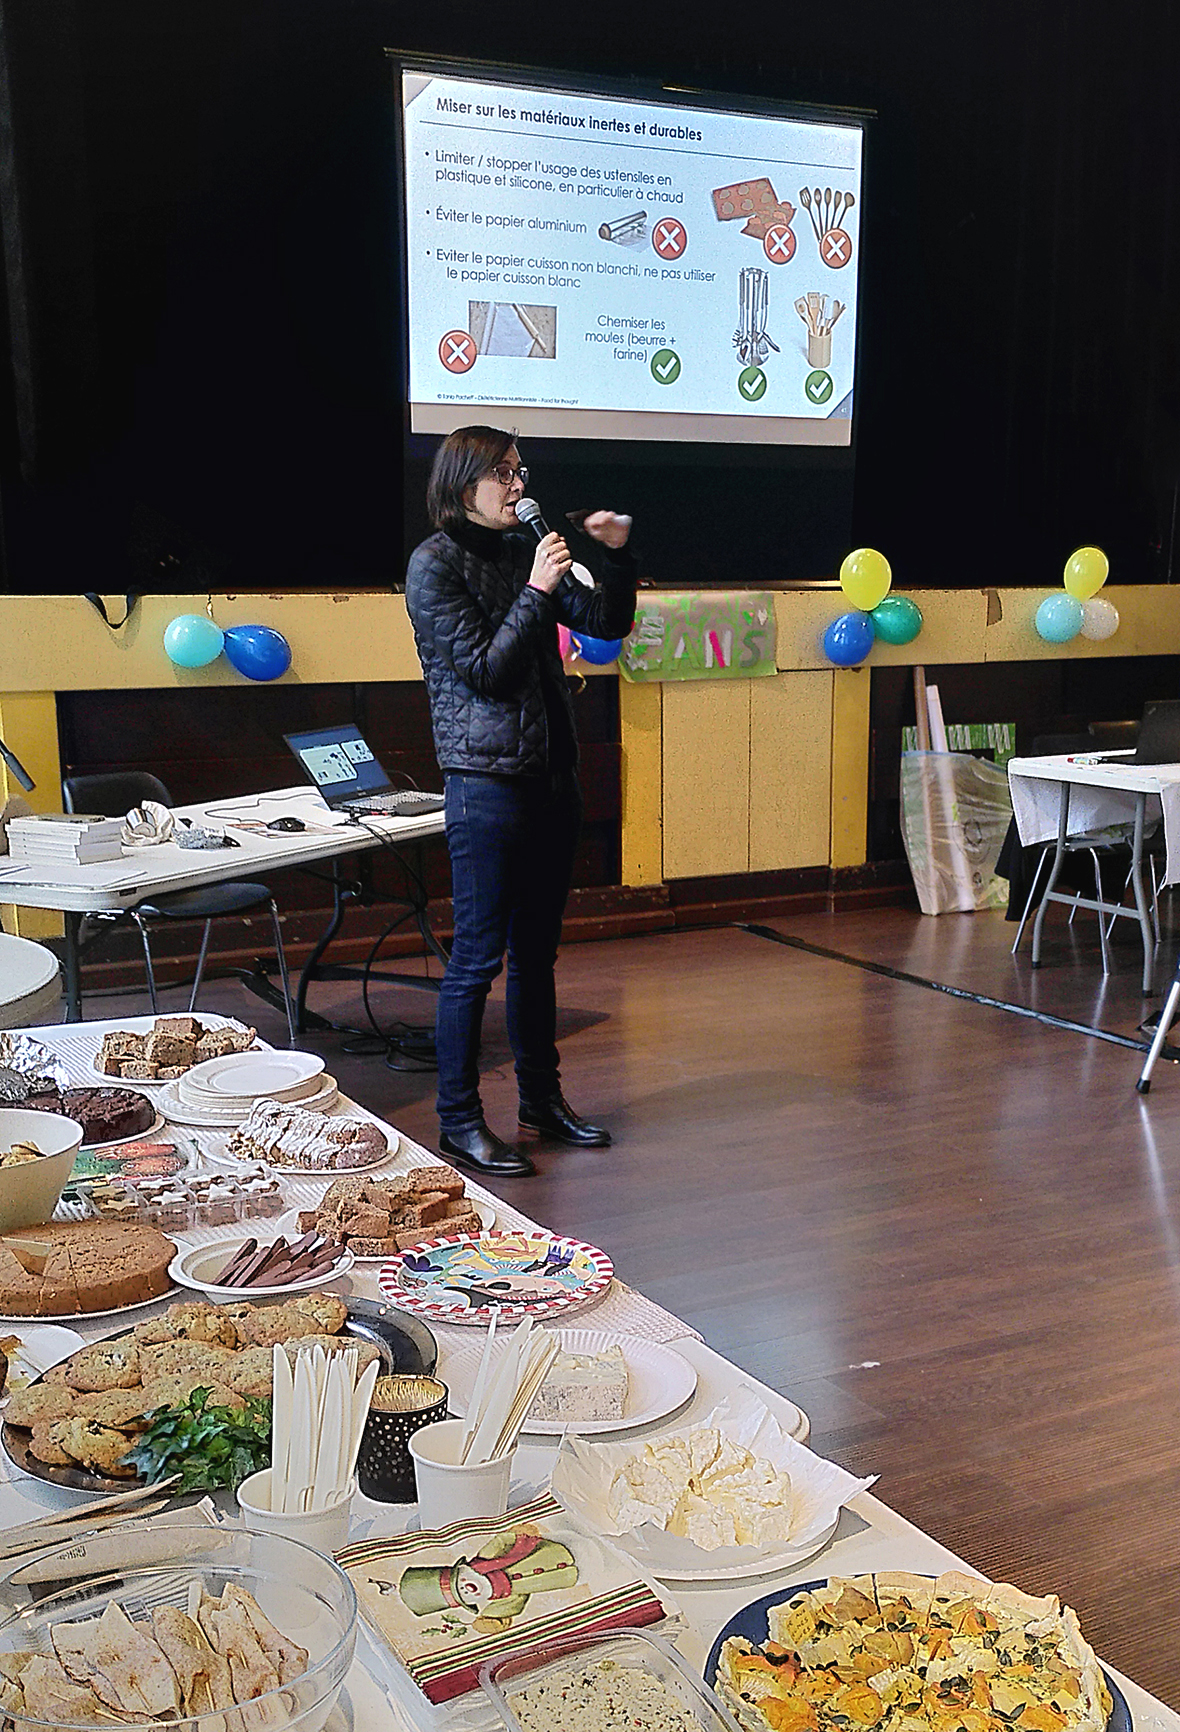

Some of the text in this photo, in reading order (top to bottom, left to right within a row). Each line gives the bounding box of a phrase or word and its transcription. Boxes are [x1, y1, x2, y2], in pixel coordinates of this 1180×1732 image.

[436, 97, 702, 141] Miser sur les matériaux inertes et durables
[435, 150, 672, 186] Limiter / stopper l'usage des ustensiles en
[435, 168, 684, 204] plastique et silicone, en particulier à chaud
[436, 206, 587, 234] Éviter le papier aluminium
[436, 248, 716, 282] Eviter le papier cuisson non blanchi, ne pas utiliser
[446, 266, 581, 288] le papier cuisson blanc
[597, 314, 666, 330] Chemiser les
[584, 332, 676, 346] moules (beurre +
[613, 348, 648, 363] farine)
